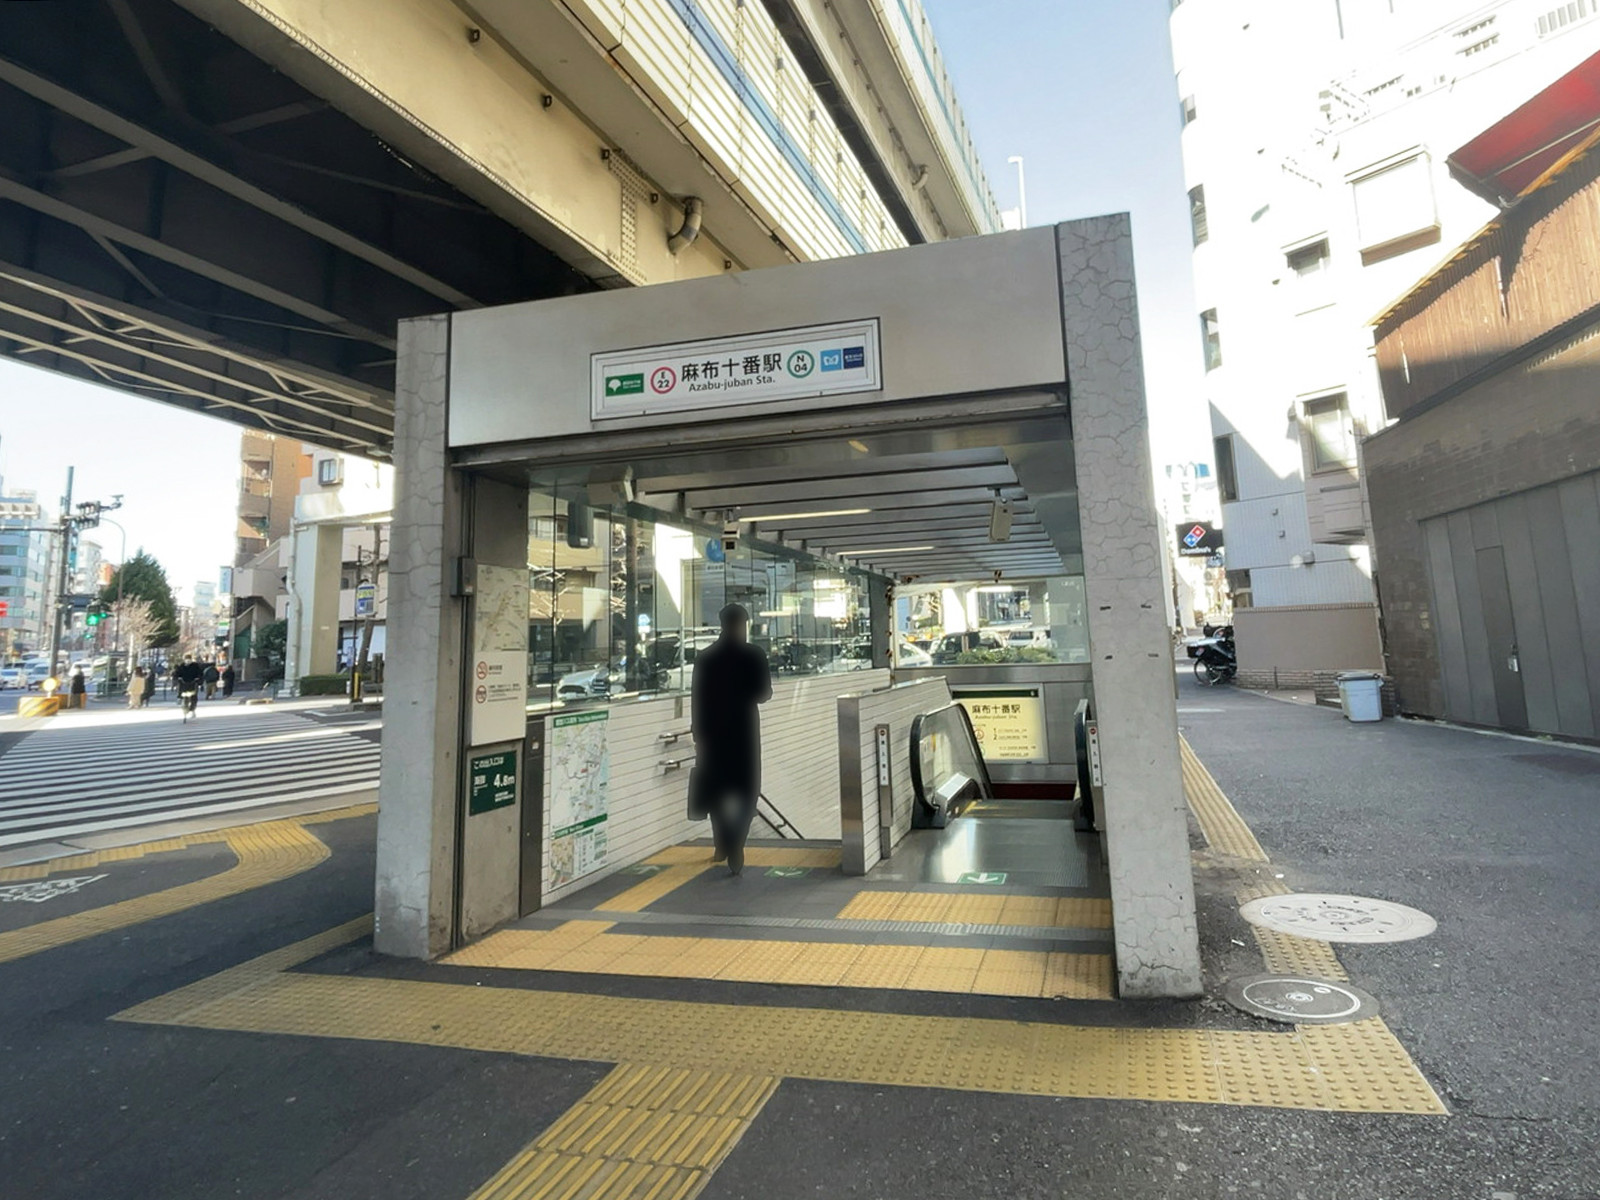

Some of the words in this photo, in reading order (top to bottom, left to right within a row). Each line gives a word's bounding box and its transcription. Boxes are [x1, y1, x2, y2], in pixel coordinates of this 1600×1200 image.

[797, 355, 804, 363] N
[681, 353, 782, 382] 麻布十番駅
[794, 363, 808, 373] 04
[660, 371, 666, 379] E
[657, 379, 670, 388] 22
[689, 378, 753, 392] Azabu-juban
[756, 375, 776, 385] Sta.
[972, 704, 1021, 714] 麻布十番駅
